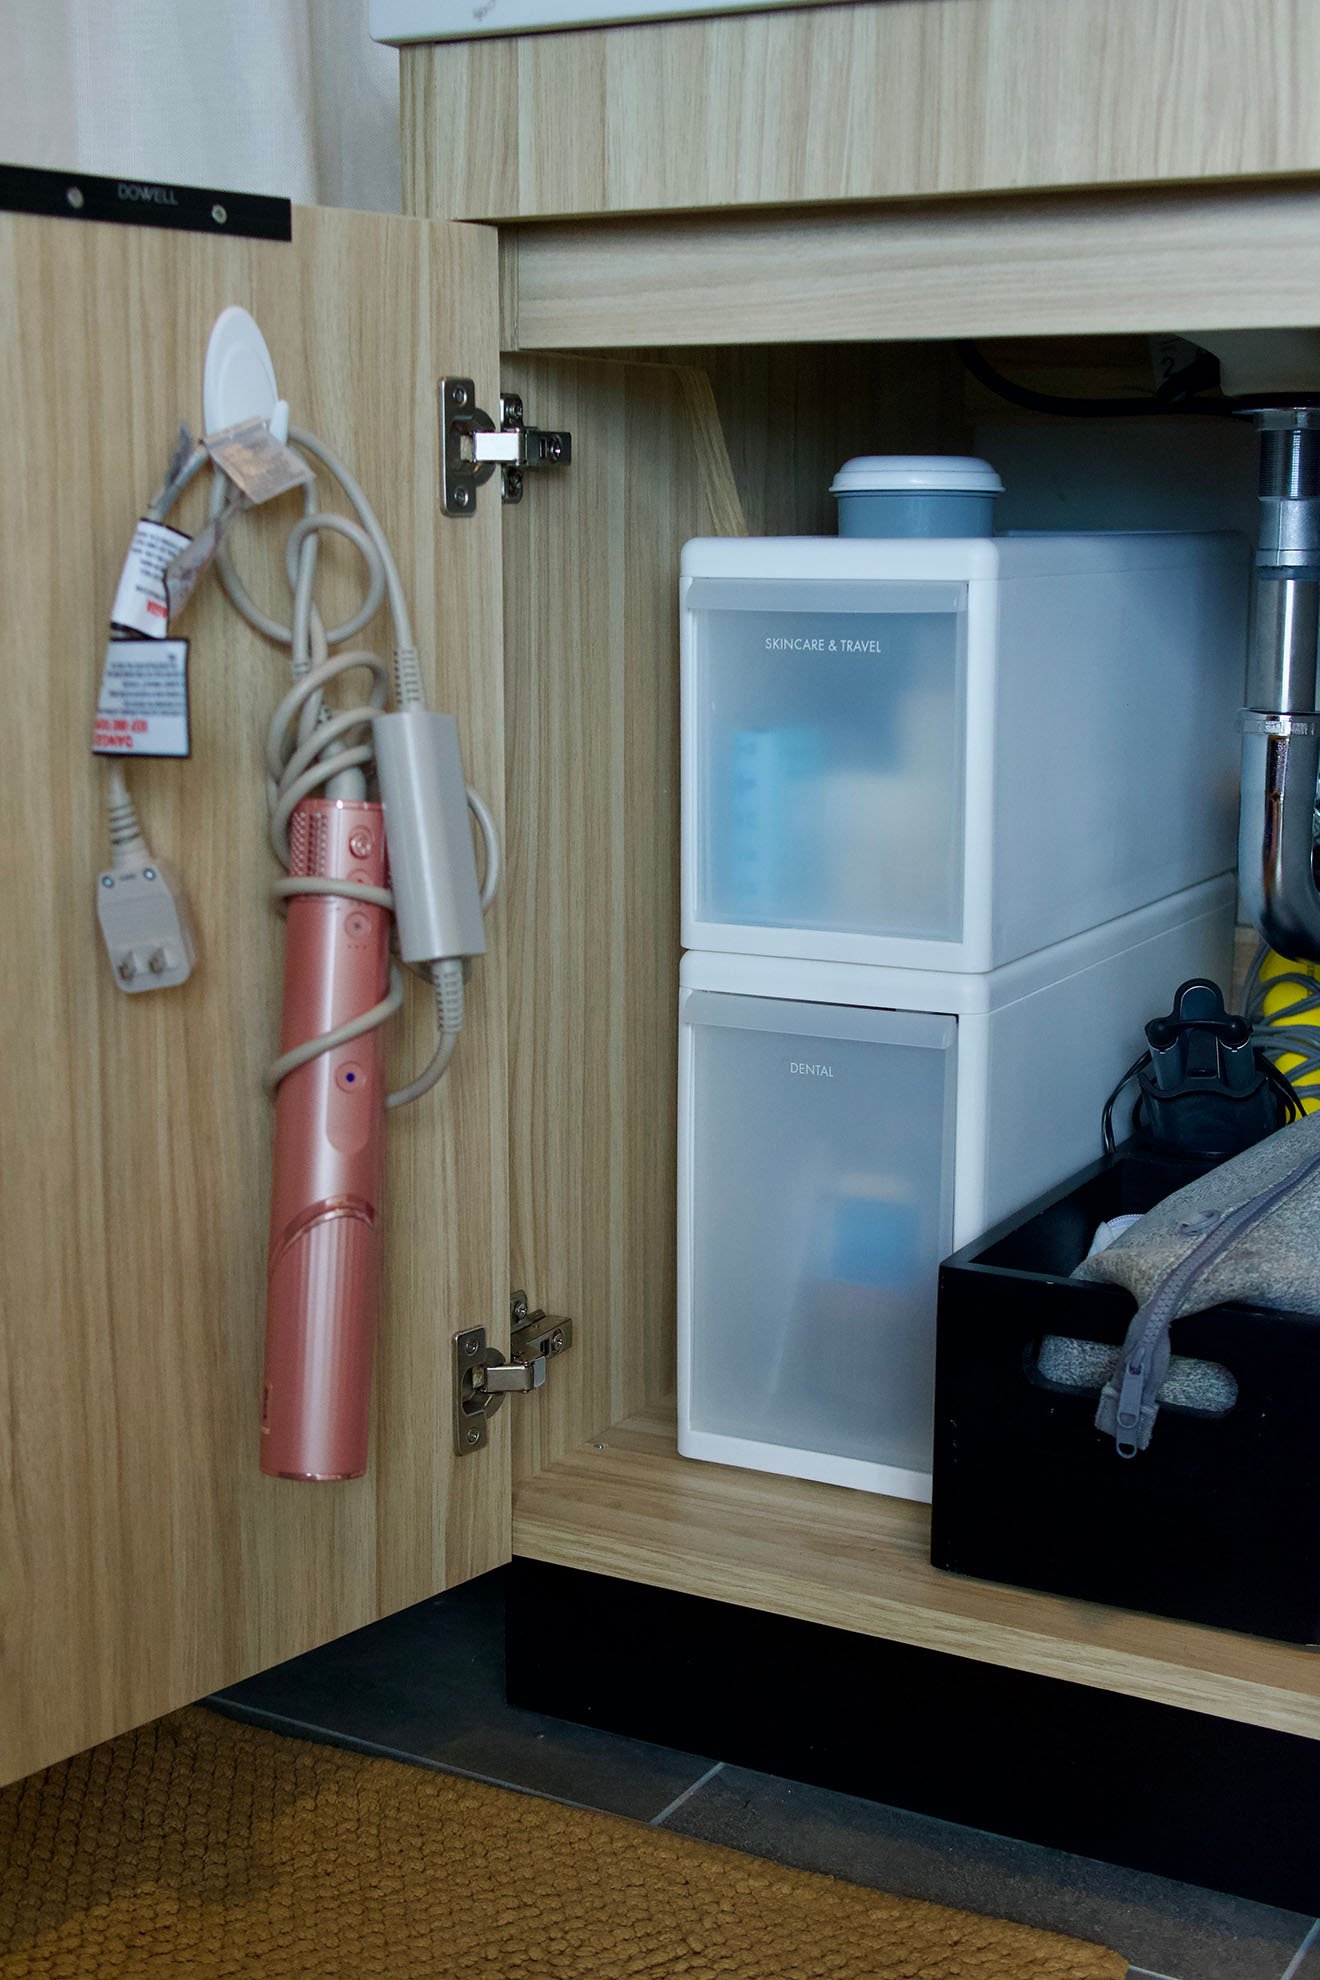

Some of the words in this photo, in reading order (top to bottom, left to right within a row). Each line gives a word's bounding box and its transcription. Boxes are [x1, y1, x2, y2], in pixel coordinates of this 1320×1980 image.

[117, 183, 178, 206] DOWELL
[765, 638, 825, 651] SKINCARE
[828, 639, 837, 652] &
[840, 640, 881, 653] TRAVEL
[790, 1062, 834, 1078] DENTAL
